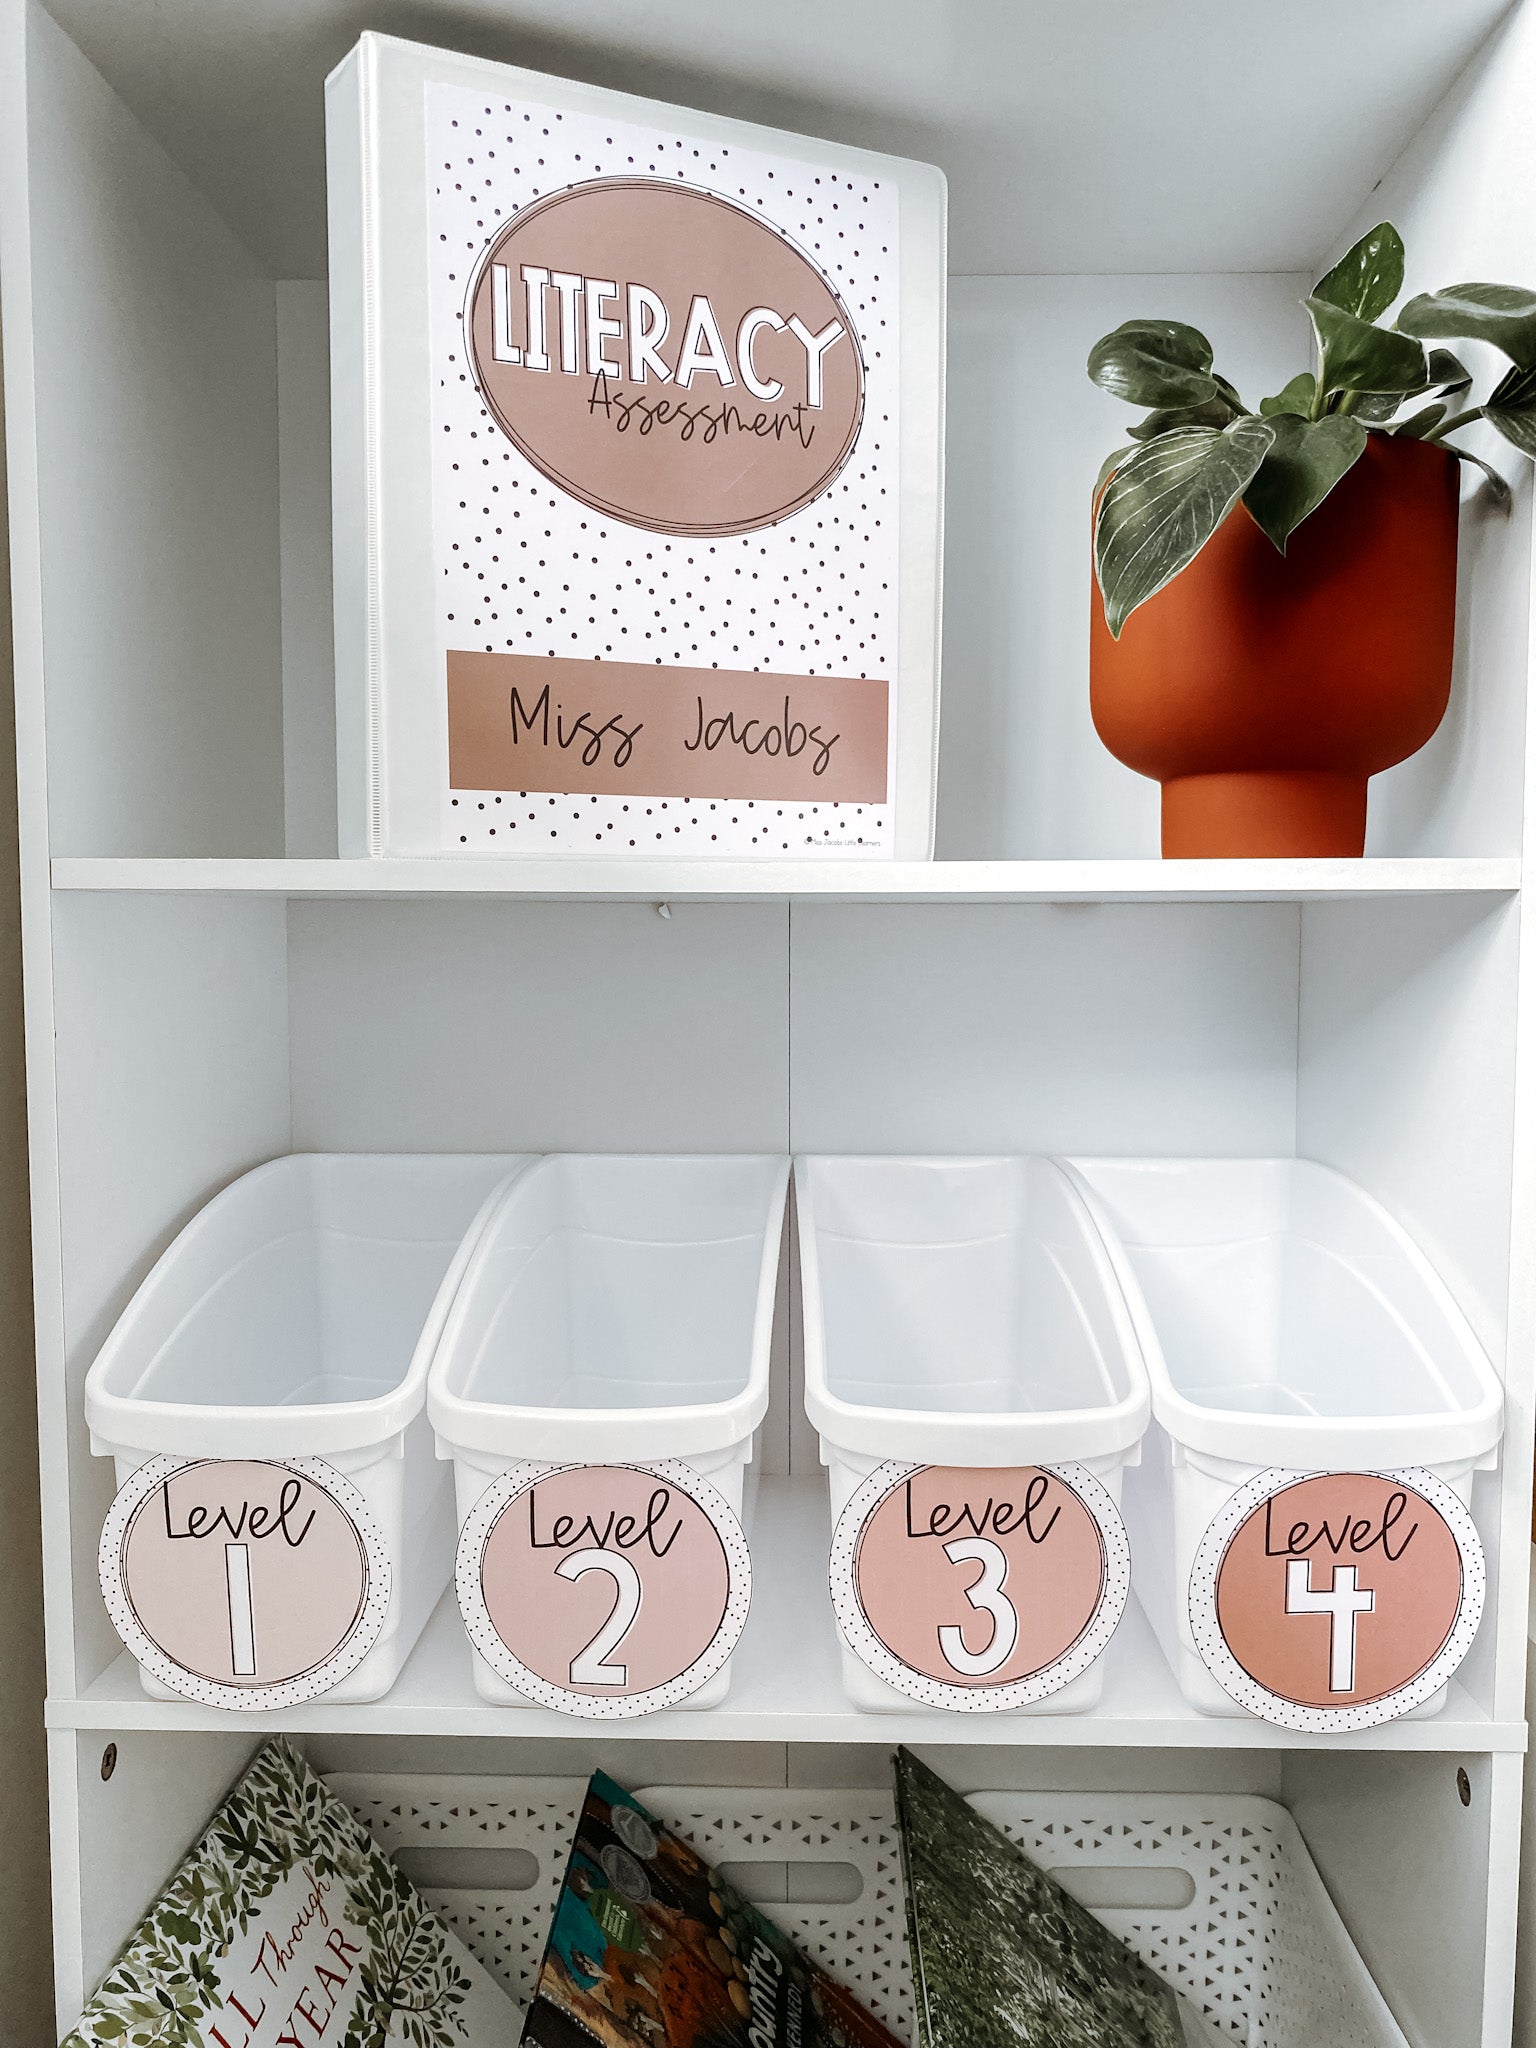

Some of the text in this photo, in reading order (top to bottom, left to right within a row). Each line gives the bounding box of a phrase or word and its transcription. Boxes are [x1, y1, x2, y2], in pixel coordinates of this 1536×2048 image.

[490, 263, 845, 411] LITERACY
[587, 368, 816, 449] Assessment
[510, 684, 841, 776] Miss Jacobs
[824, 838, 842, 846] Jacobs
[844, 838, 857, 847] Little
[858, 839, 881, 847] earners
[163, 1479, 317, 1547] Level
[528, 1488, 683, 1557] Level
[905, 1475, 1062, 1544] Level
[1263, 1492, 1419, 1562] Level
[225, 1543, 257, 1678] 1
[553, 1547, 642, 1687] 2
[937, 1536, 1019, 1679] 3
[1284, 1558, 1376, 1694] 4
[250, 1866, 332, 1986] Through
[276, 1927, 363, 2048] YEAR
